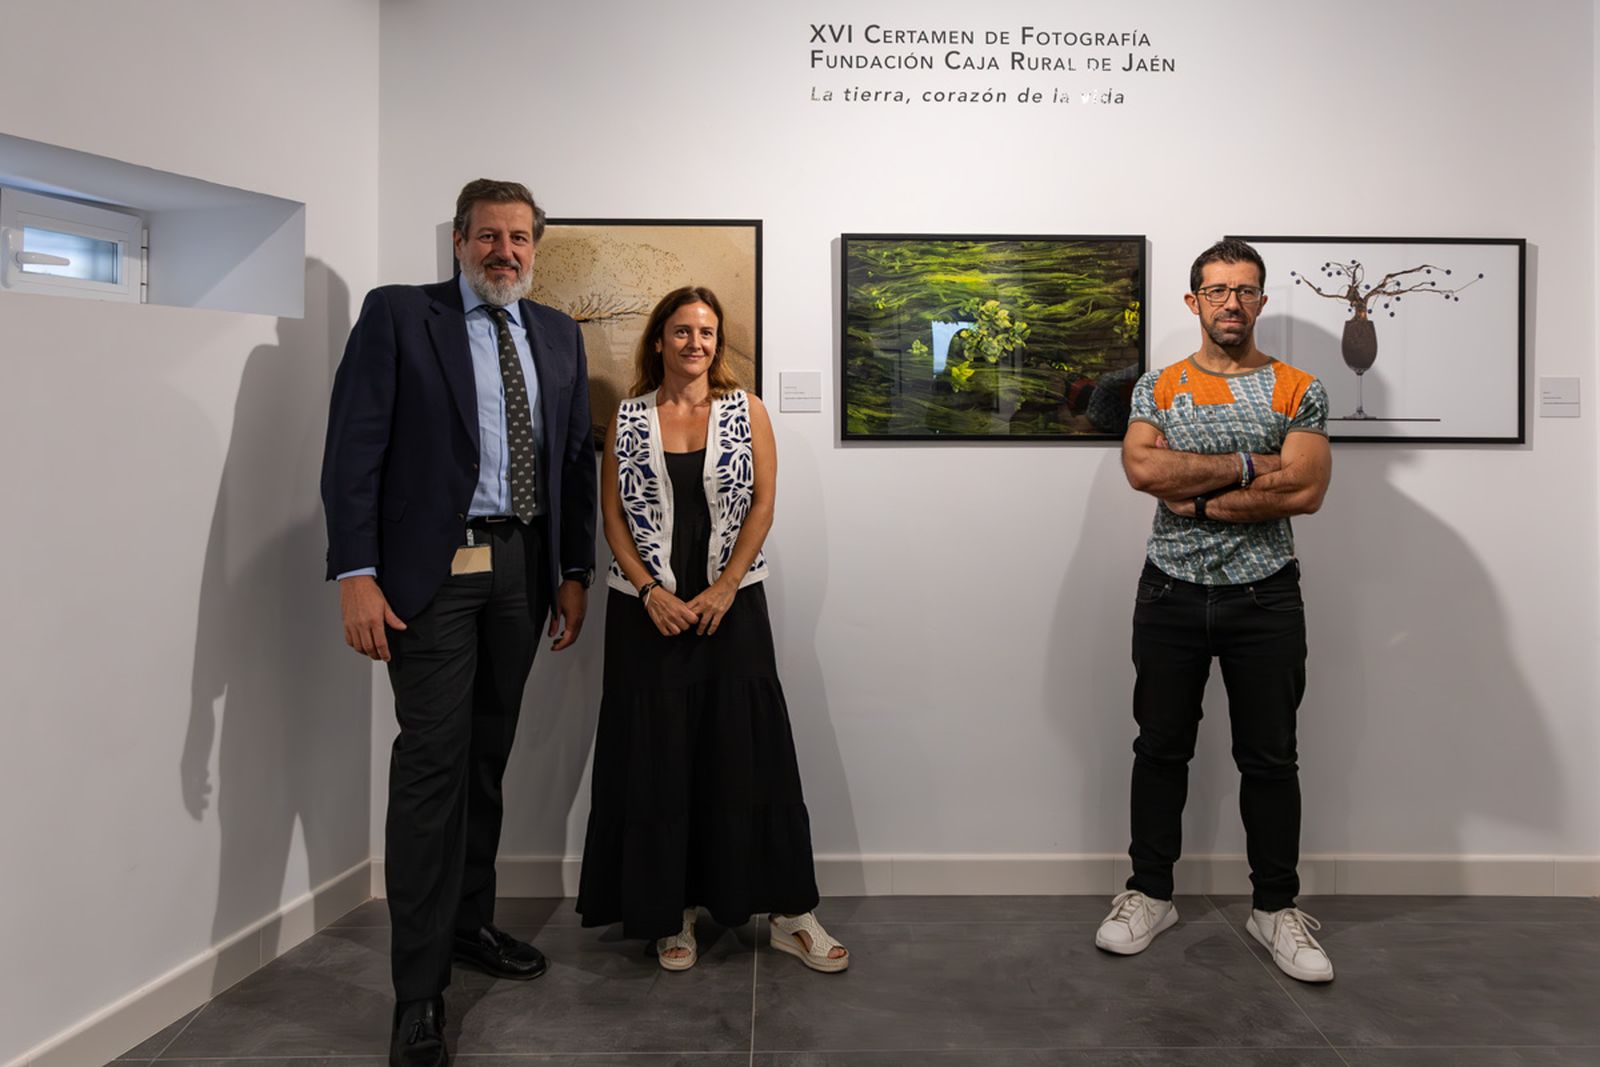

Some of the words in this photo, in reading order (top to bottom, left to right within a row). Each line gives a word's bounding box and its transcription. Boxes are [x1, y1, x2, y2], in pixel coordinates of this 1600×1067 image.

[810, 24, 852, 43] XVI
[864, 24, 974, 44] CERTAMEN
[985, 31, 1010, 45] DE
[1021, 26, 1151, 47] FOTOGRAFÍA
[811, 50, 933, 69] FUNDACIÓN
[944, 51, 999, 70] CAJA
[1011, 52, 1076, 71] RURAL
[1087, 58, 1112, 71] DE
[1122, 53, 1175, 72] JAÉN
[811, 87, 833, 101] La
[844, 86, 911, 104] tierra,
[922, 87, 1006, 103] corazón
[1017, 87, 1042, 103] de
